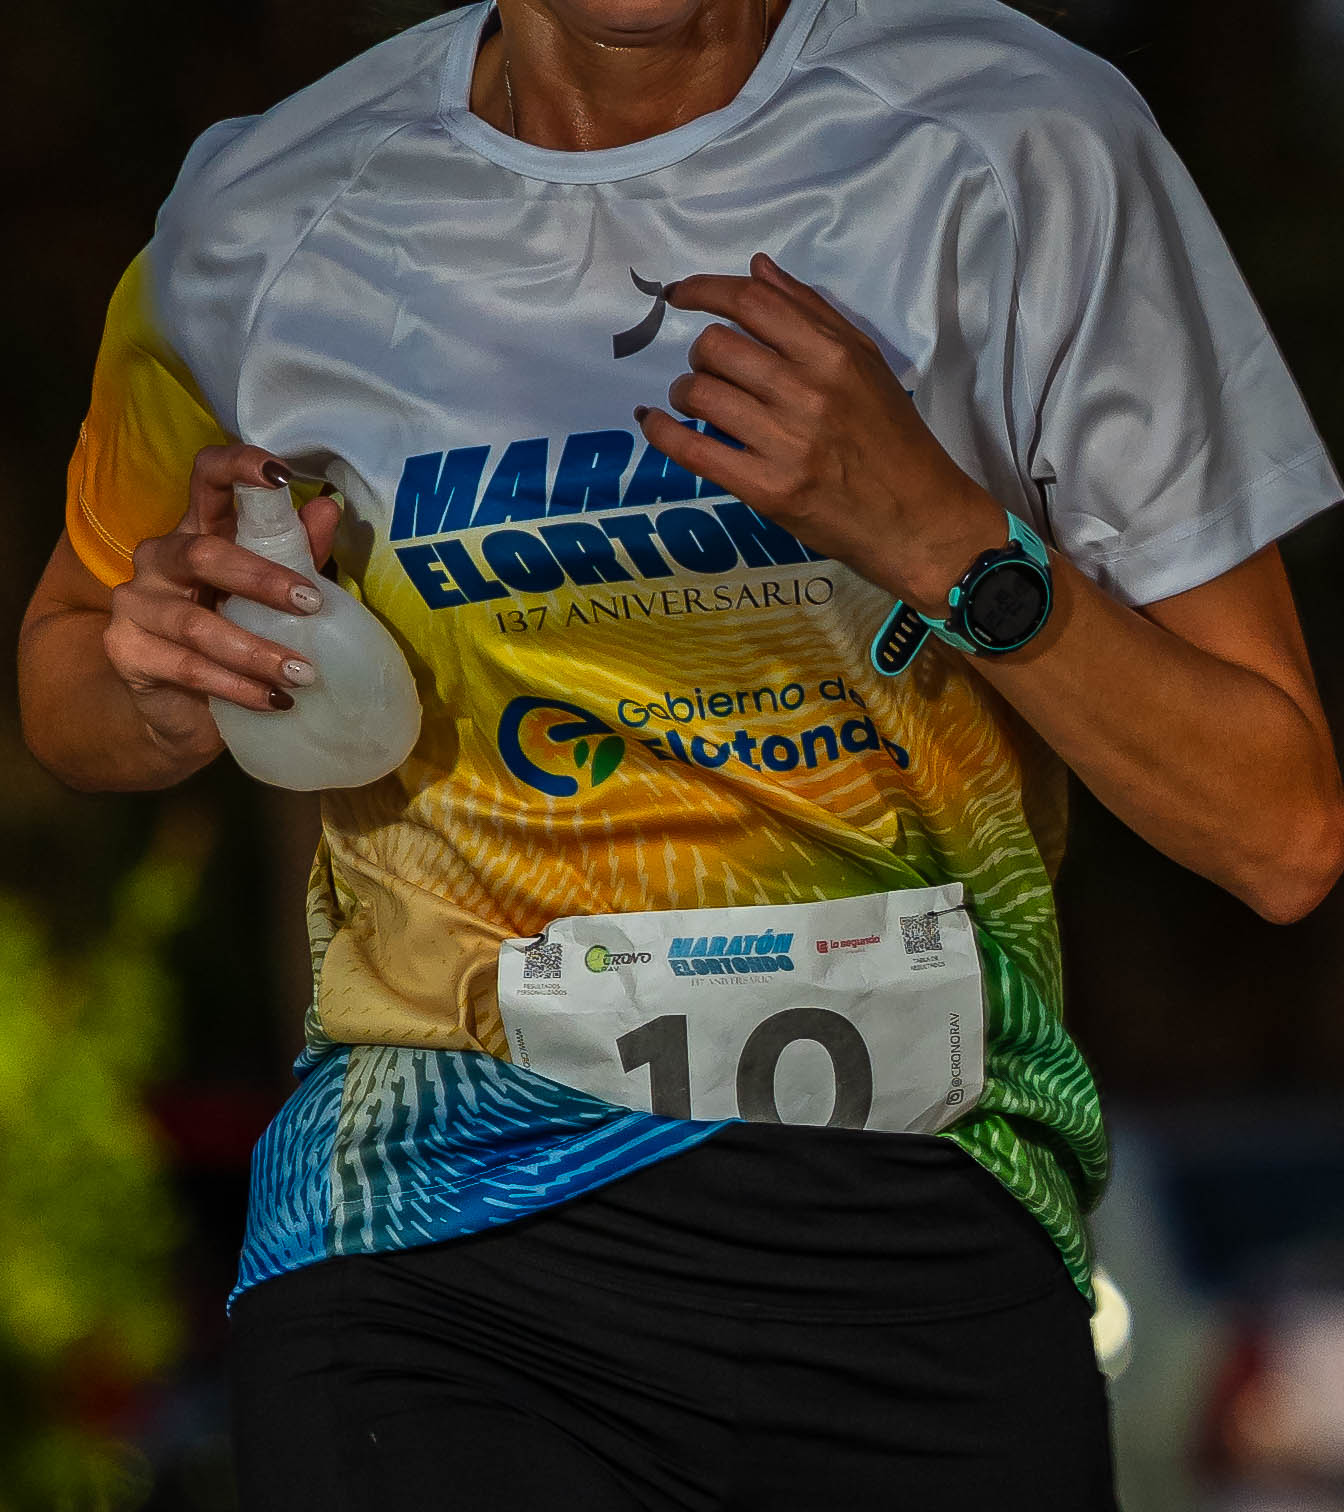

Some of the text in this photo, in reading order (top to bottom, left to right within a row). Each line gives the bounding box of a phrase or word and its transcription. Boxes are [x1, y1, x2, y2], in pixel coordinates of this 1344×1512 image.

[390, 416, 754, 541] MARA
[395, 502, 832, 610] ELORTON
[496, 575, 834, 636] 137 ANIVERSARIO
[618, 682, 805, 728] Gobierno
[668, 928, 794, 958] MARATÓN
[668, 955, 795, 977] ELORTONDO
[616, 1007, 873, 1131] 10
[948, 1012, 962, 1088] @CRONORAV
